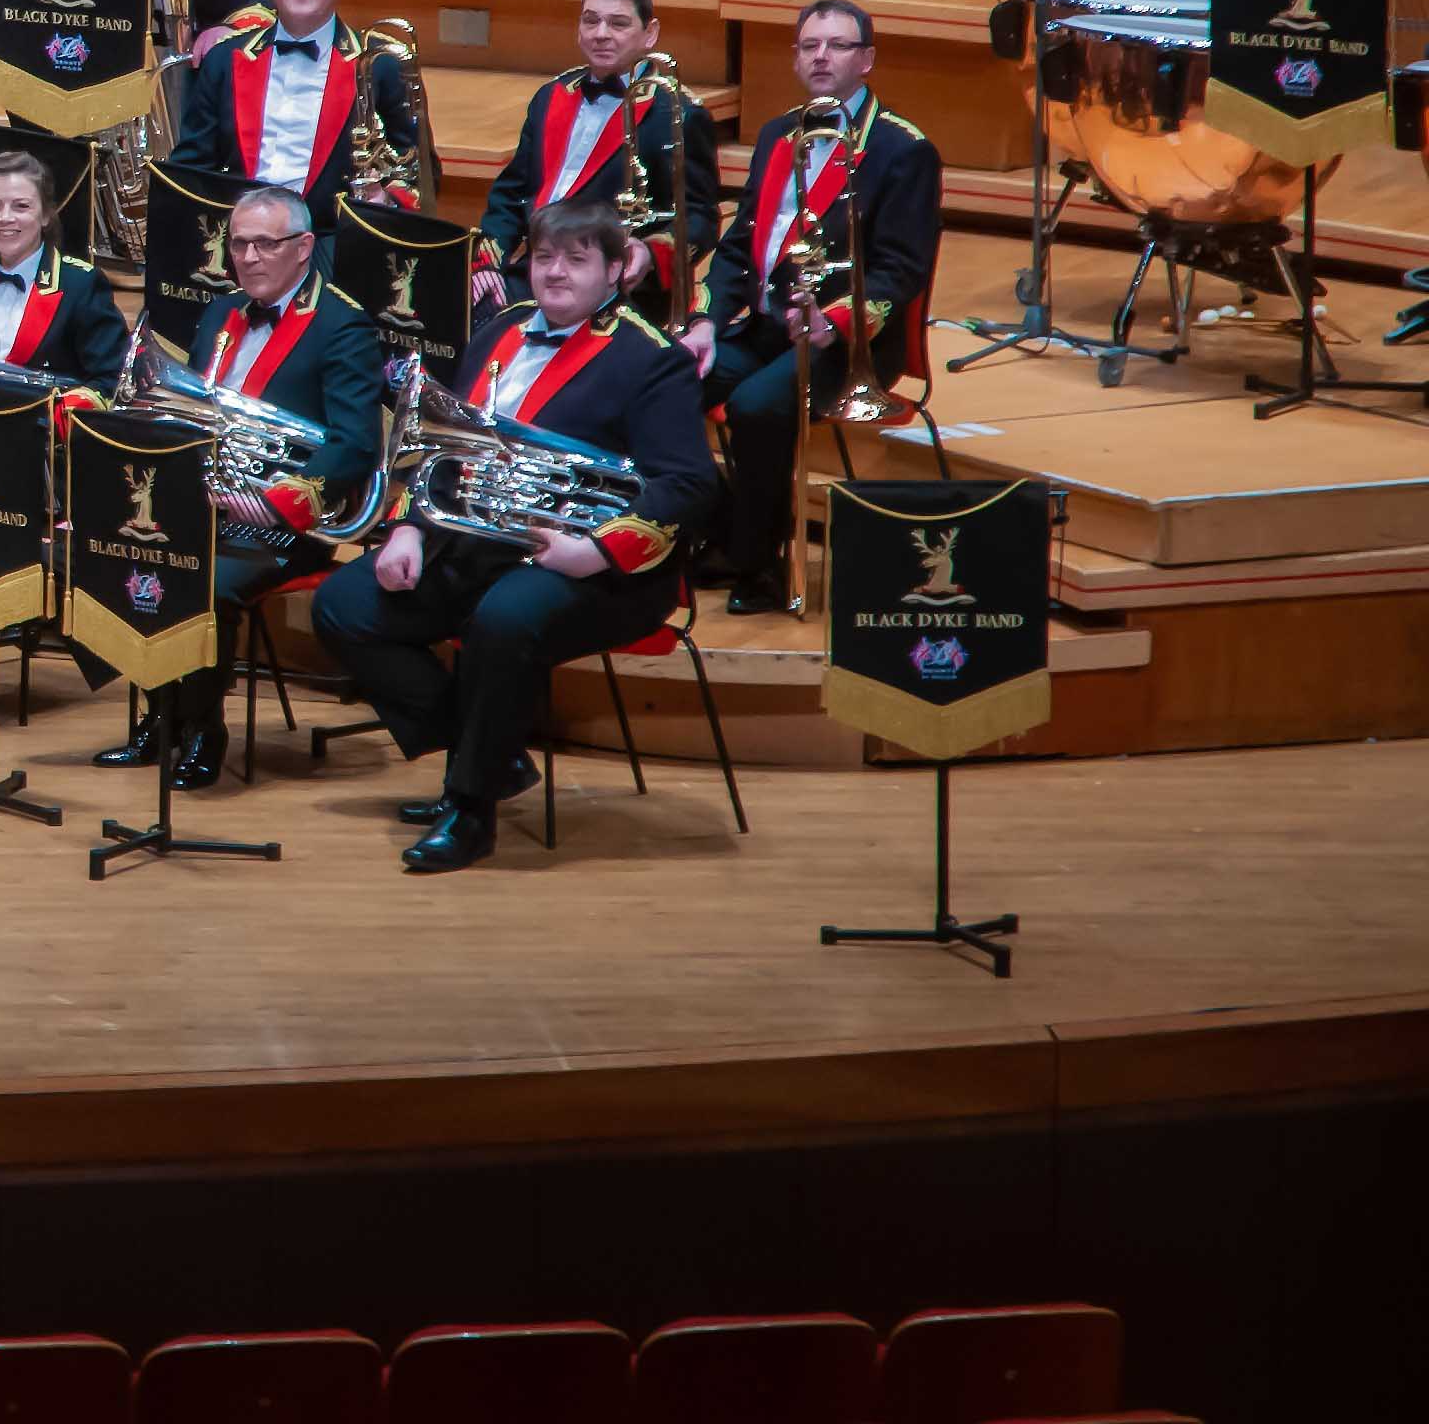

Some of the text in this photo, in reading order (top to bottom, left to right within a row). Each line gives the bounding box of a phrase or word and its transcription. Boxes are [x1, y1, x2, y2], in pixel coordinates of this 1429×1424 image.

[5, 8, 132, 31] BLACK DYKE BAND
[1230, 32, 1279, 47] BLACK
[1329, 39, 1368, 55] BAND
[425, 340, 455, 359] BAND
[90, 539, 199, 570] BLACK DYKE BAND
[856, 613, 1023, 628] BLACK DYKE BAND
